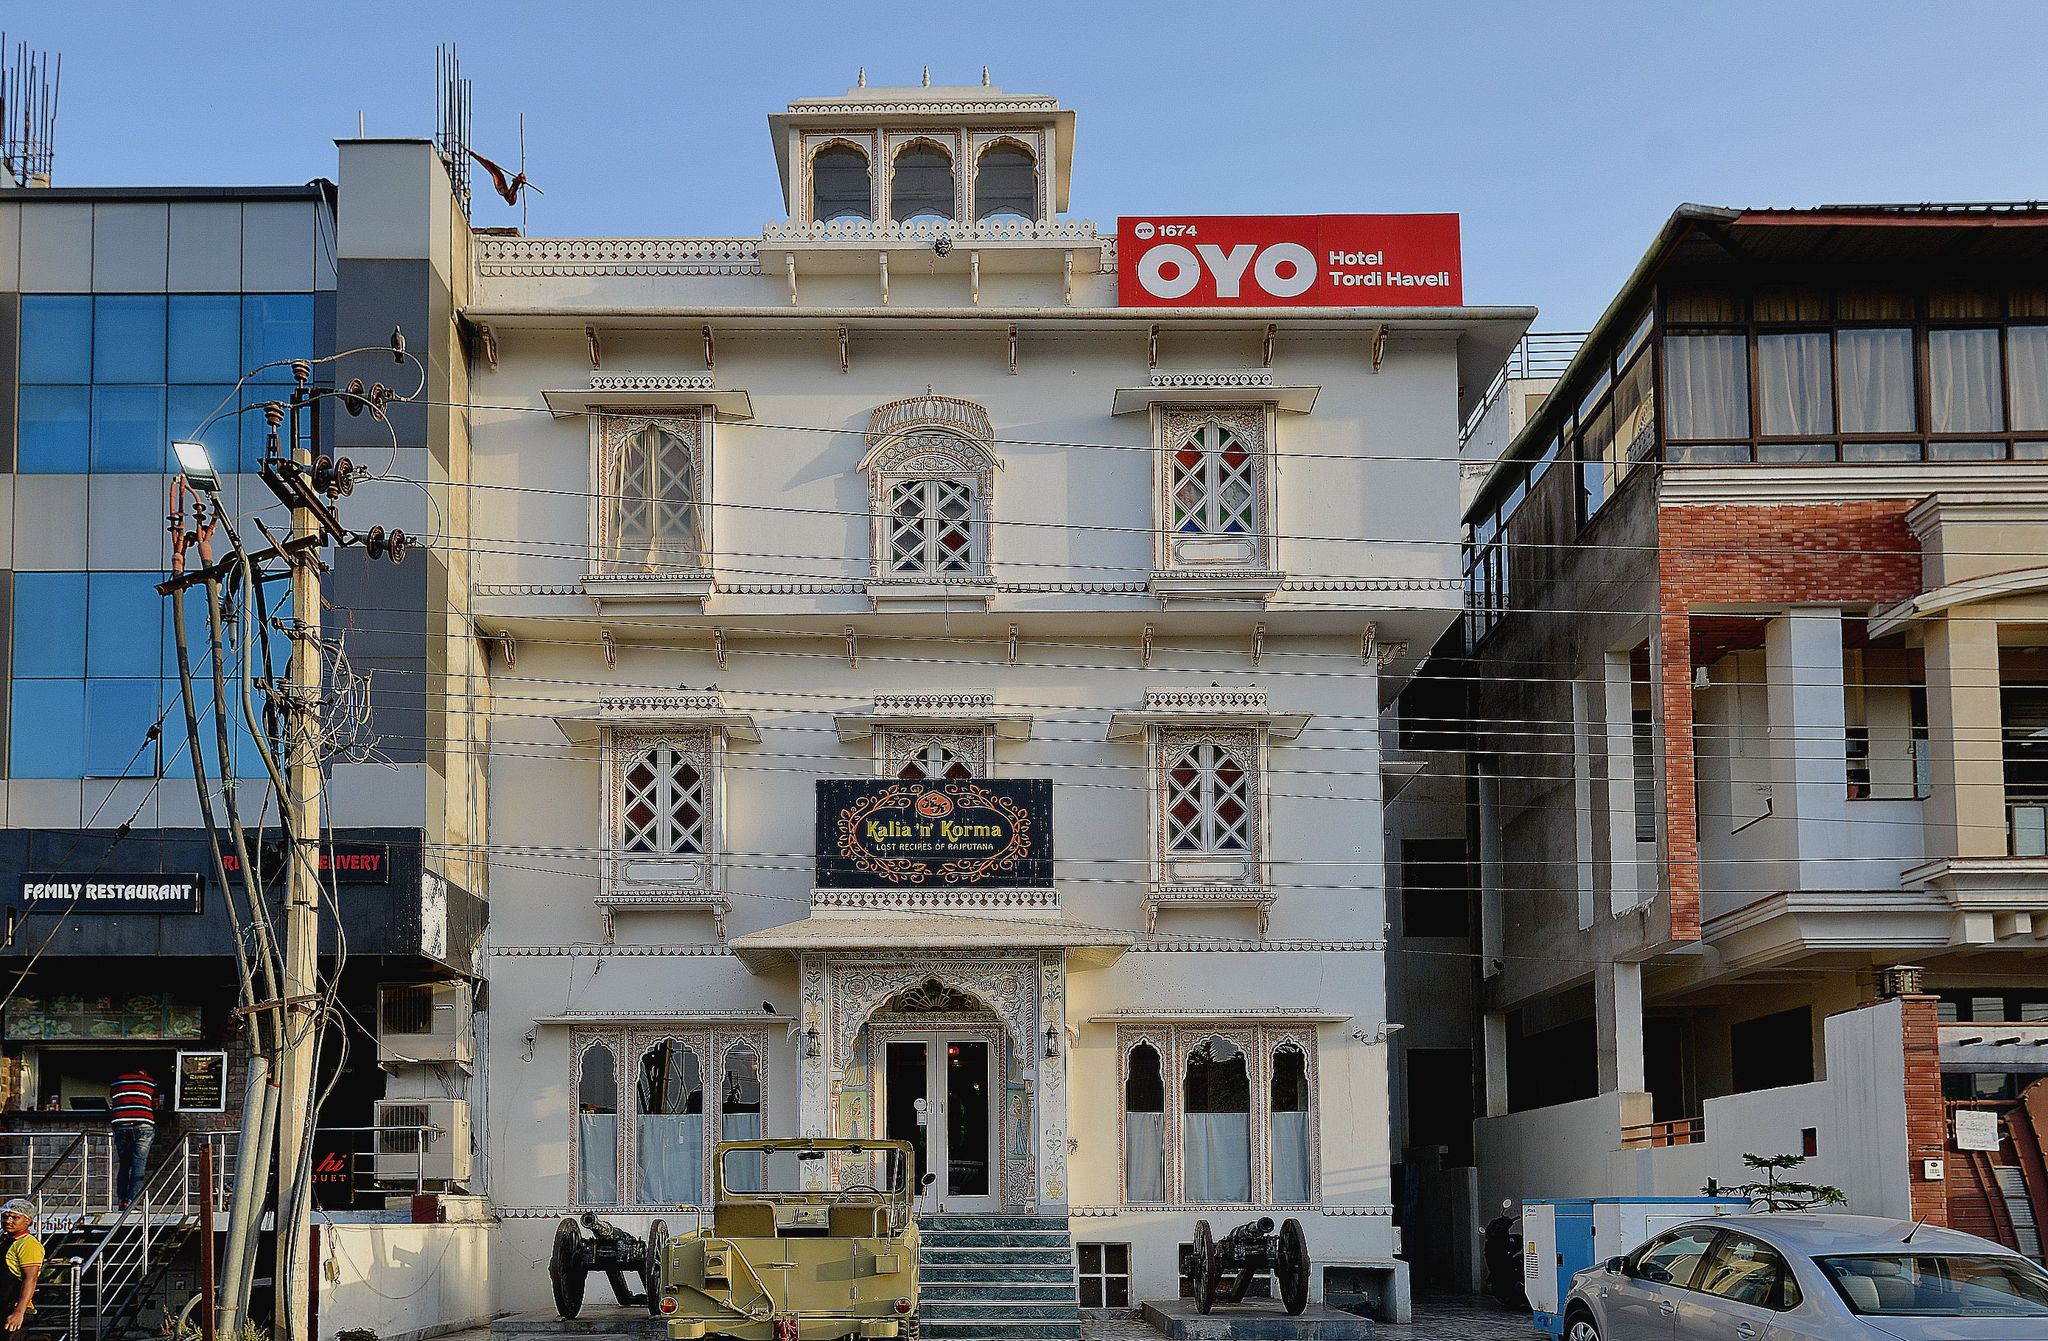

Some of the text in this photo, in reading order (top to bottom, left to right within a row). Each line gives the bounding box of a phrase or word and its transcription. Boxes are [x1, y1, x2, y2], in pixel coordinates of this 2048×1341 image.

[1158, 224, 1197, 237] 1674
[1329, 251, 1383, 266] Hotel
[1137, 242, 1318, 299] OYO
[1329, 271, 1450, 287] Tordi Haveli
[866, 819, 912, 843] Kalia
[941, 820, 1003, 843] Korma
[876, 843, 994, 851] LOST RECIPES OF RAJPUTANA
[319, 855, 381, 871] EIVERY
[23, 883, 192, 900] FAMILY RESTAURANT
